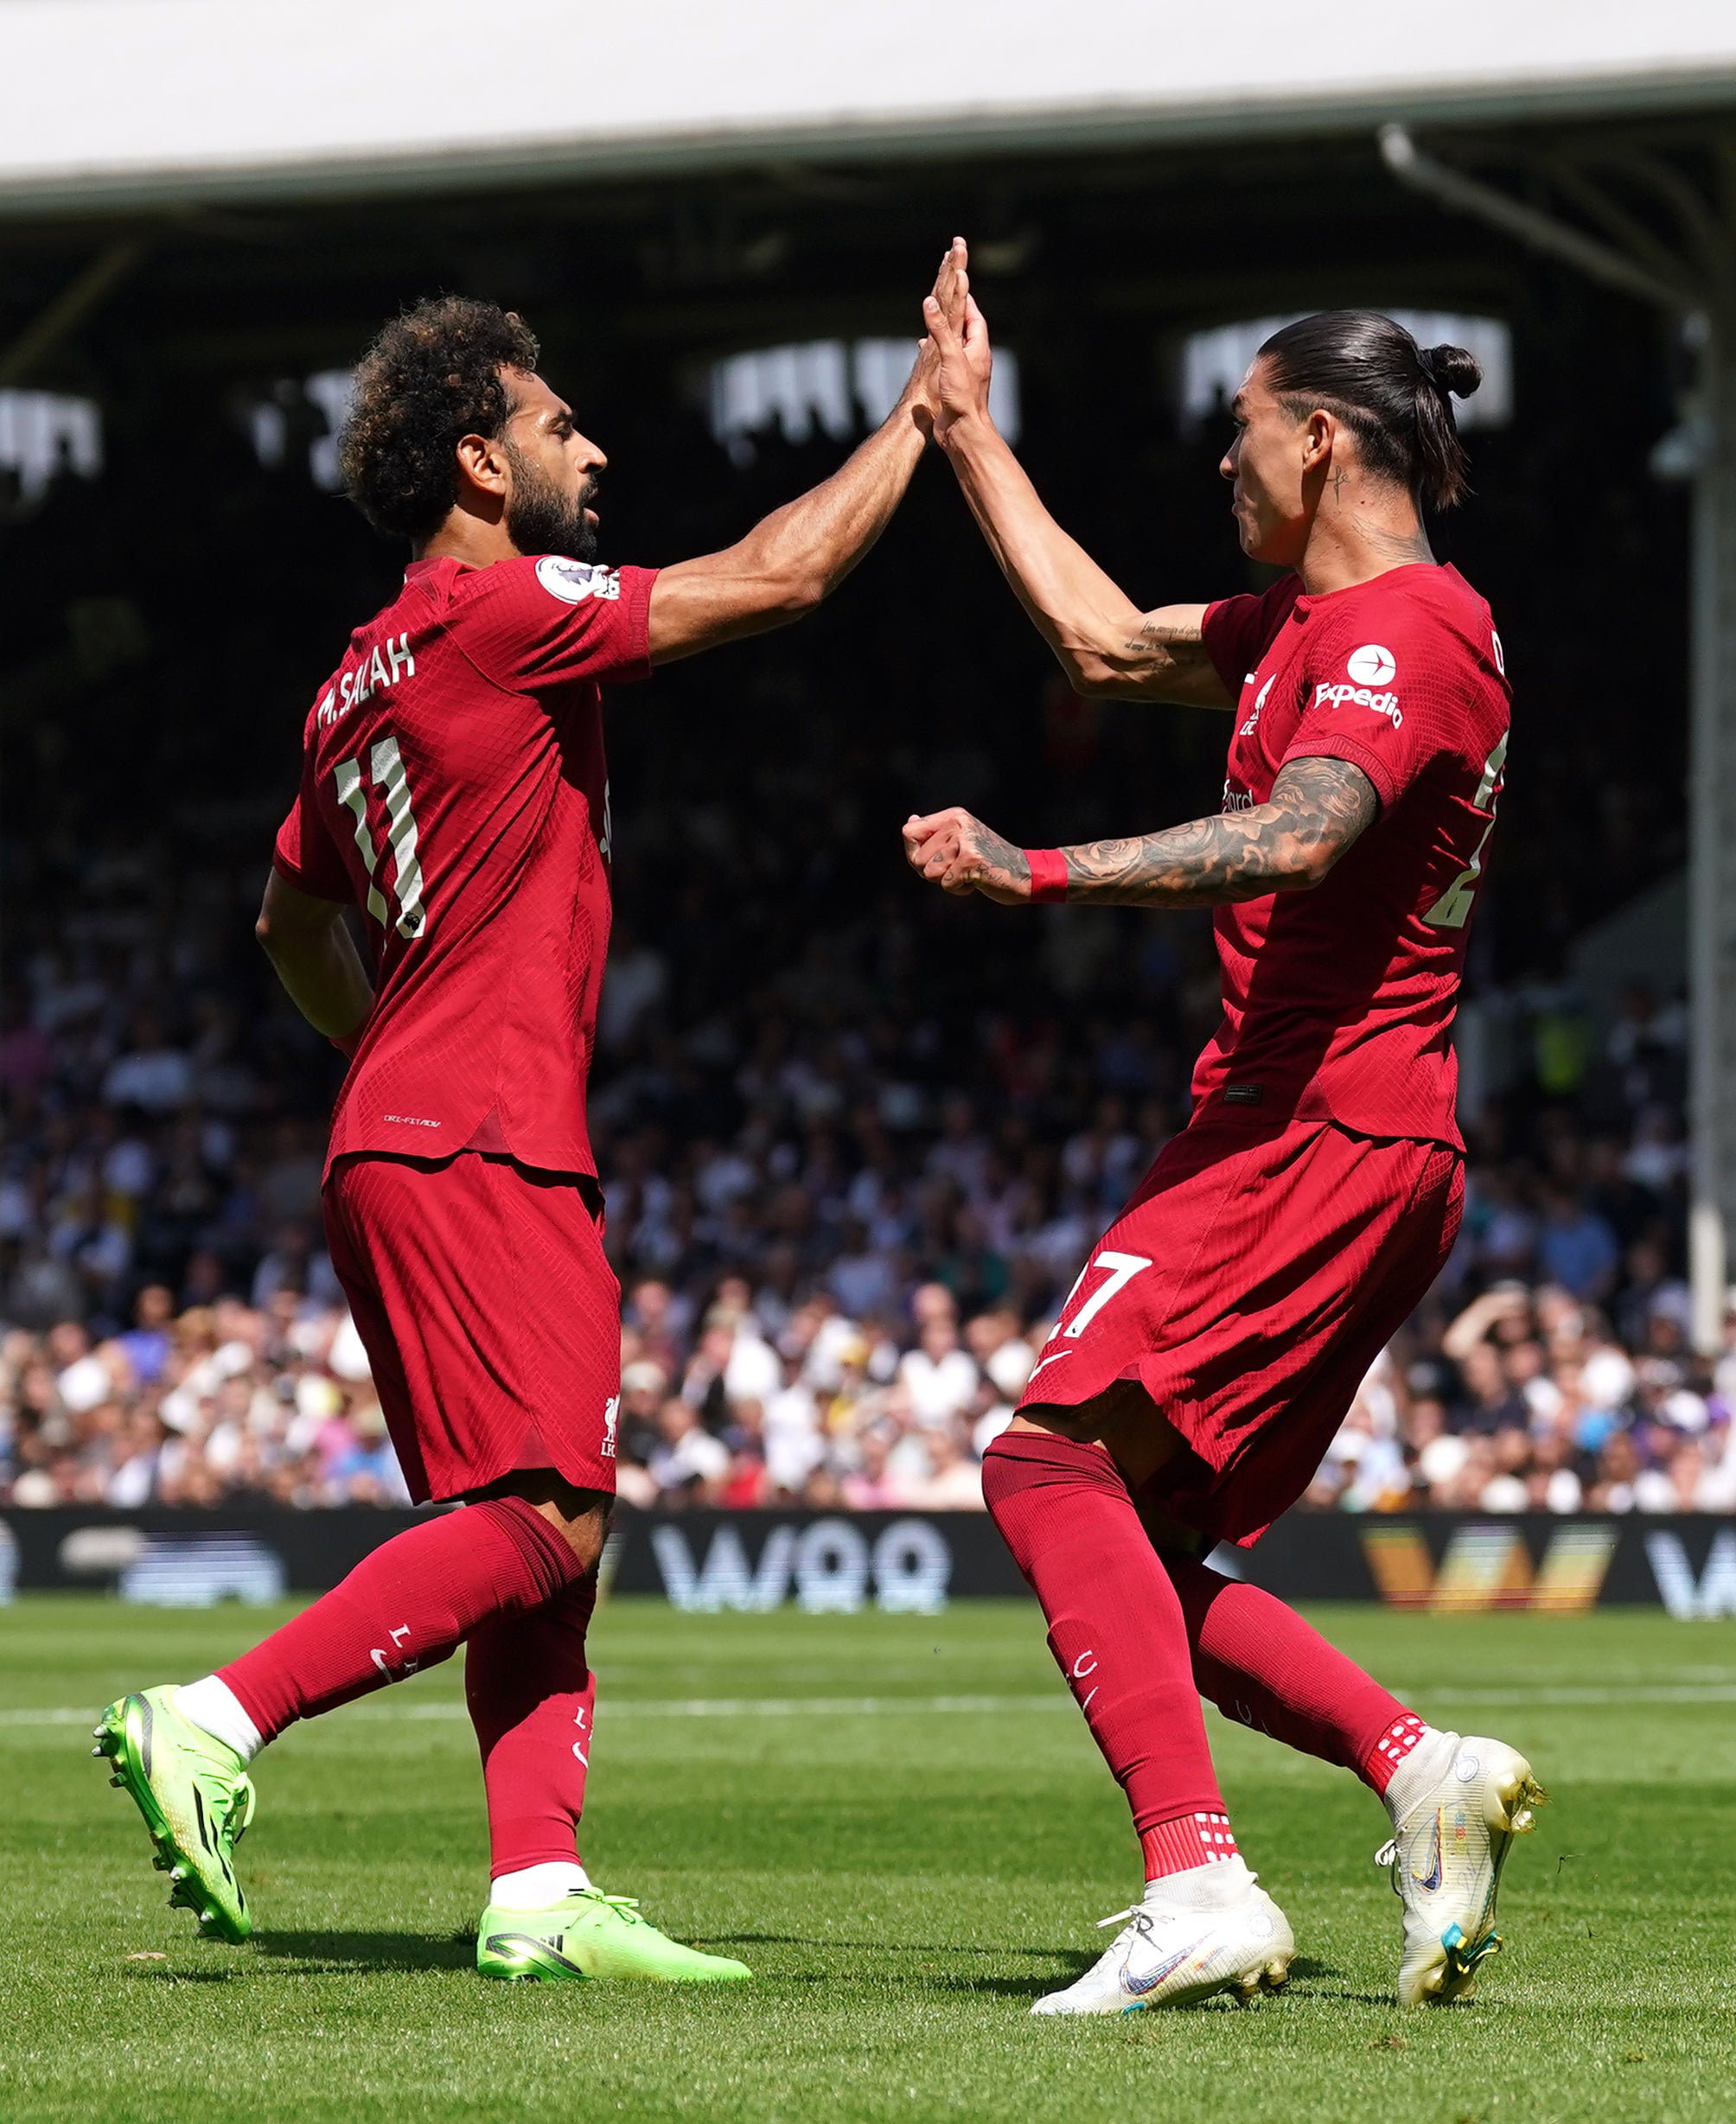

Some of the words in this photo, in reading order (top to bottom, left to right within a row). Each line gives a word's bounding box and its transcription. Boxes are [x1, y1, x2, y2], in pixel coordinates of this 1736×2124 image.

[317, 632, 416, 730] M.SALAH
[1491, 629, 1505, 676] D
[334, 736, 425, 949] 11
